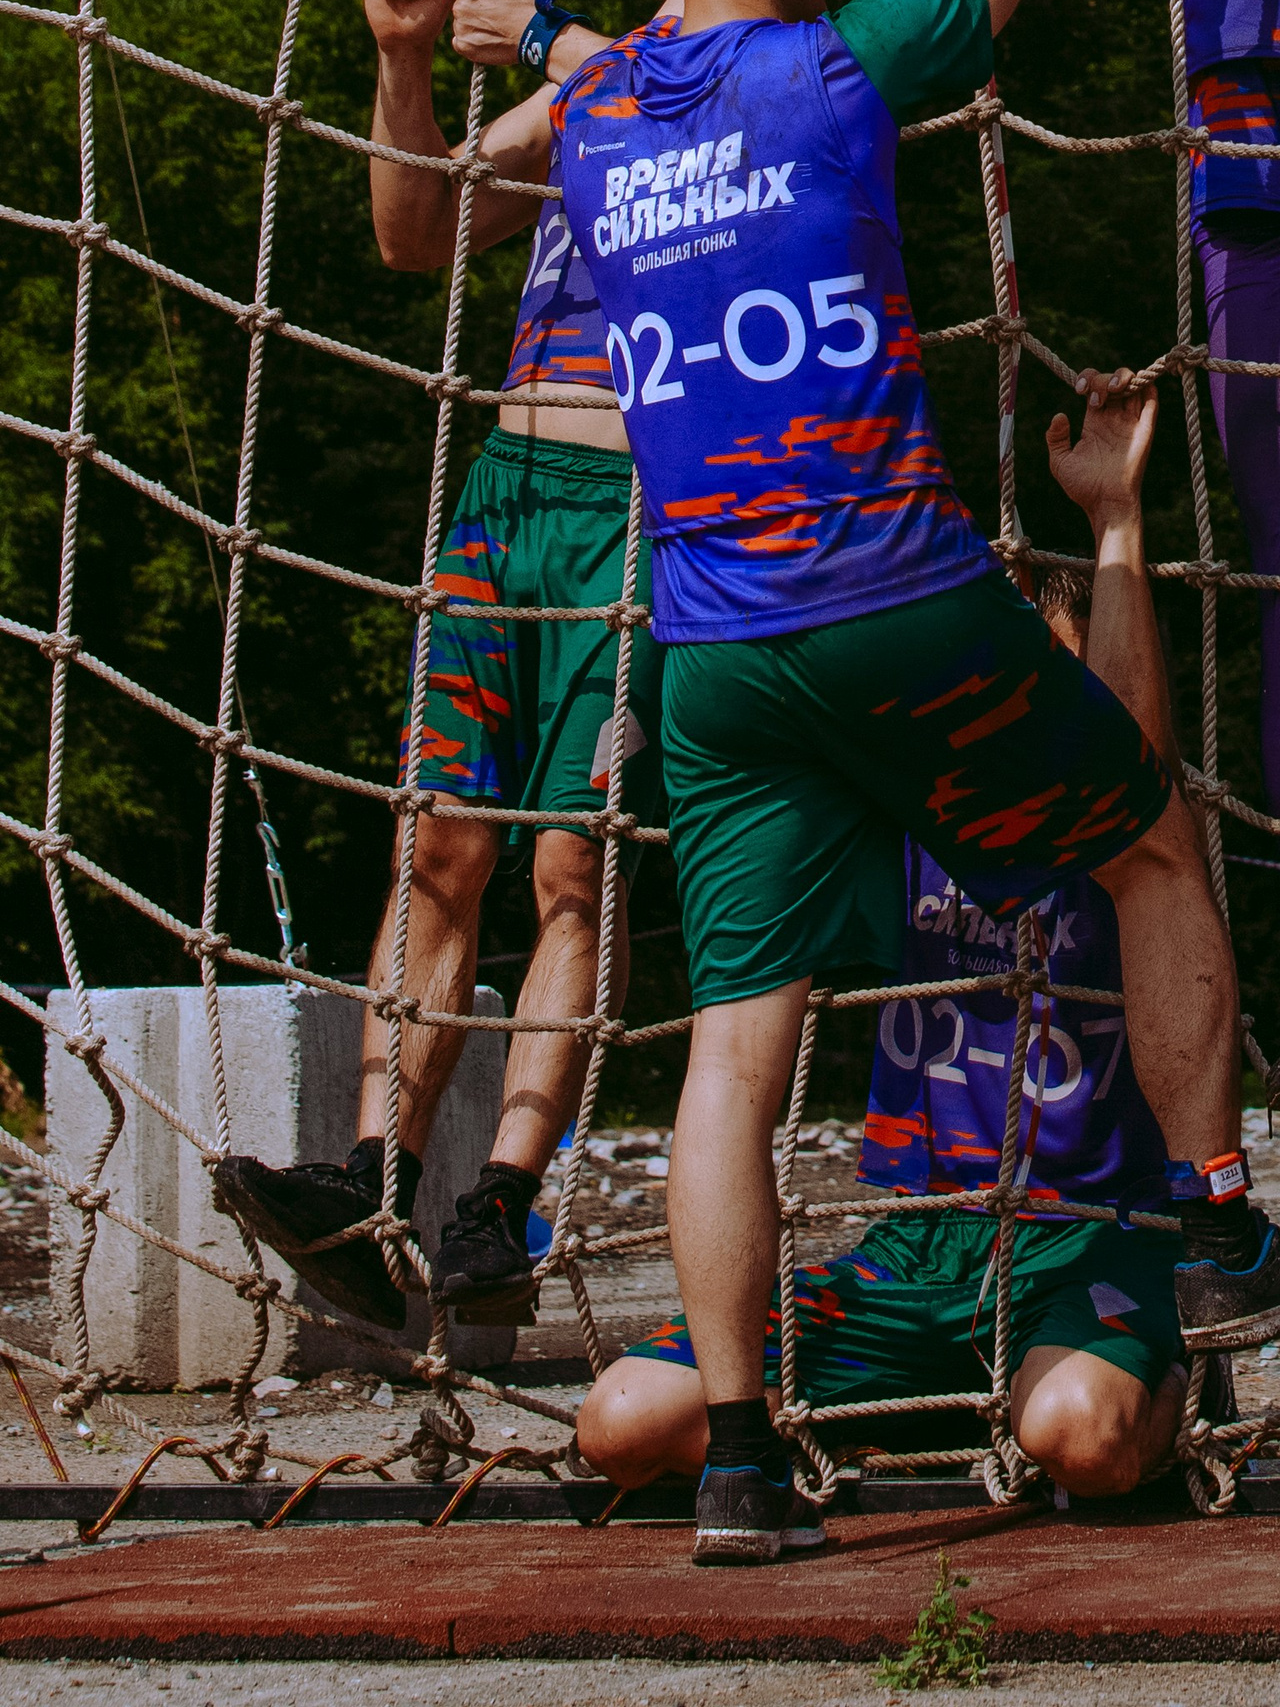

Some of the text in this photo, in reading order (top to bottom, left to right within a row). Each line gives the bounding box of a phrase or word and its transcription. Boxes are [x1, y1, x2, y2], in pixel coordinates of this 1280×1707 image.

[585, 141, 626, 155] Ростелеком
[605, 130, 744, 211] ВРЕМЯ
[593, 161, 797, 257] СИЛЬНЫХ
[632, 228, 738, 275] БОЛЬШАЯ ГОНКА
[605, 273, 879, 413] 02-05
[880, 996, 1127, 1103] 02-07
[1220, 1166, 1240, 1182] 1211
